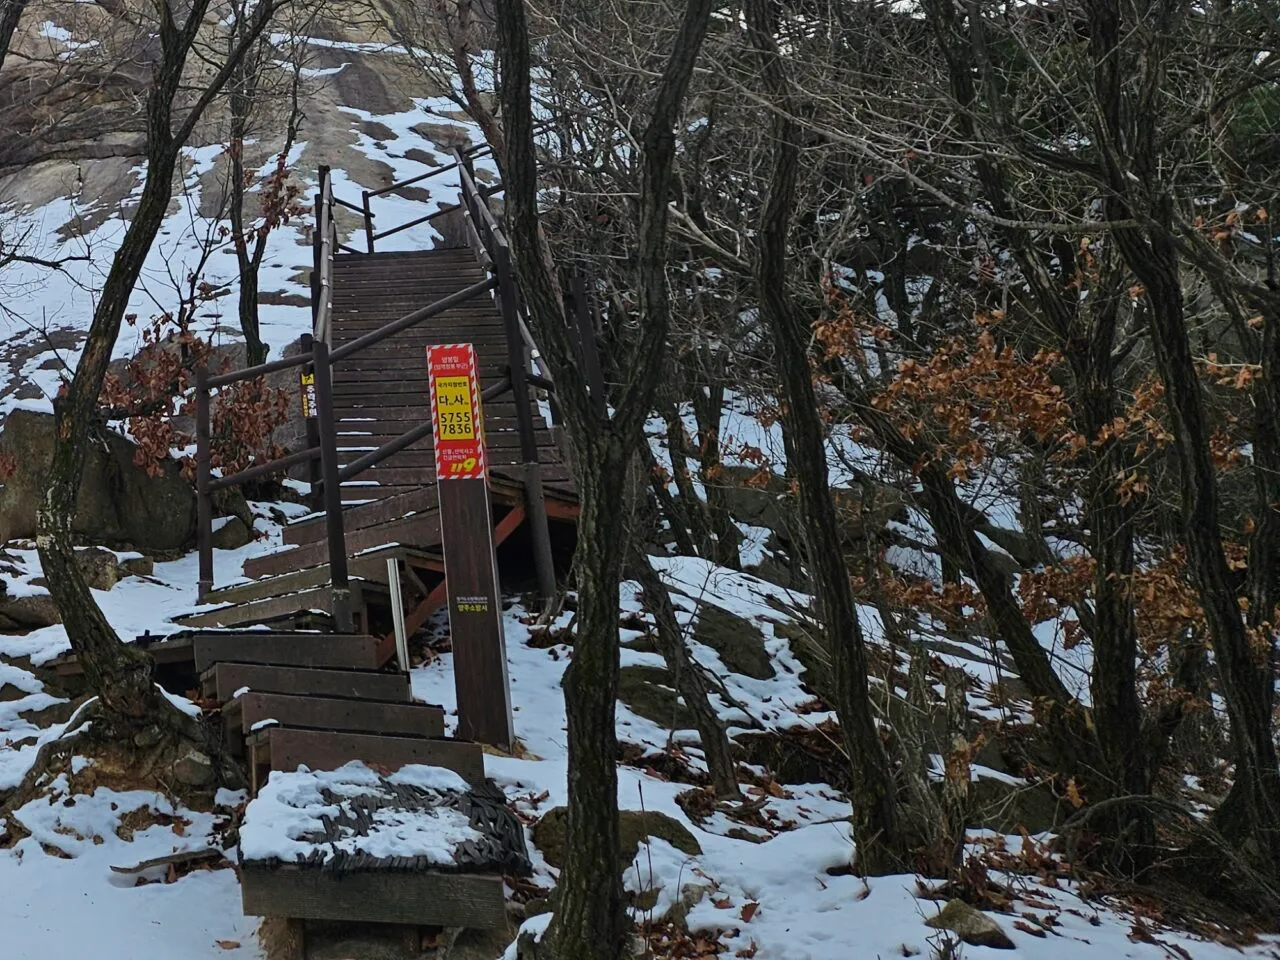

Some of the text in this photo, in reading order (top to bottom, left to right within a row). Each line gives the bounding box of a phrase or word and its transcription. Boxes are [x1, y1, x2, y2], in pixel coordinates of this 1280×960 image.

[439, 394, 464, 405] 다 사
[441, 412, 470, 423] 5755
[441, 424, 471, 434] 7836
[450, 458, 476, 472] 119
